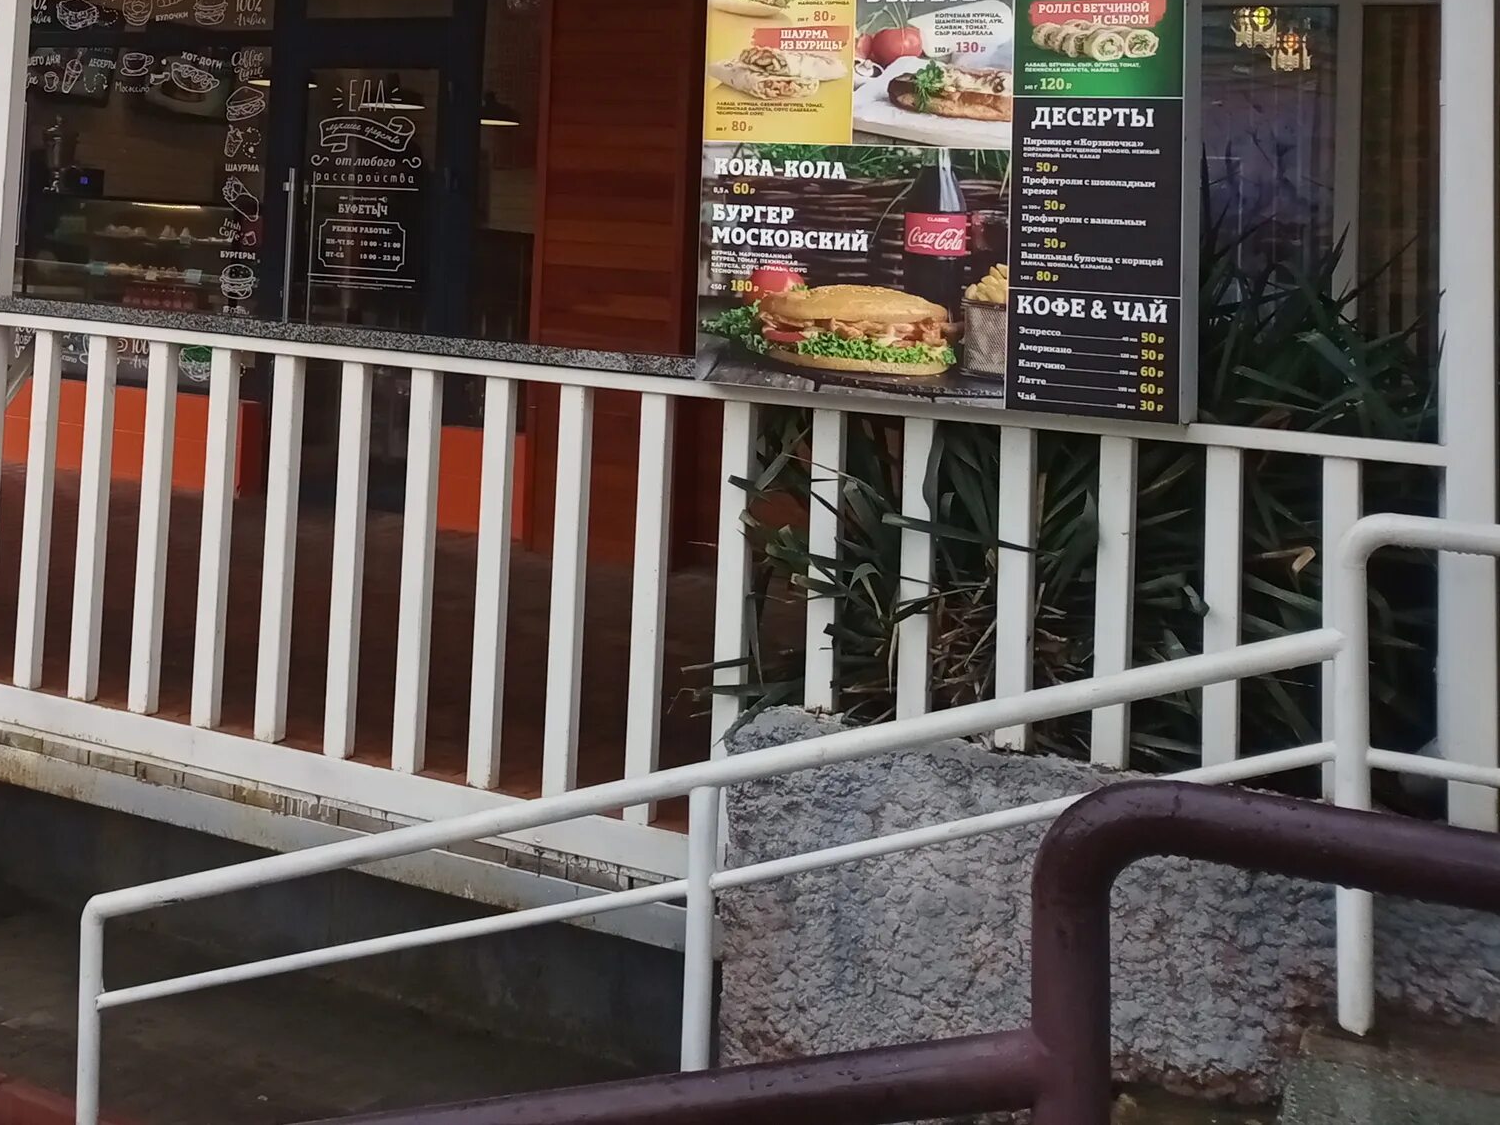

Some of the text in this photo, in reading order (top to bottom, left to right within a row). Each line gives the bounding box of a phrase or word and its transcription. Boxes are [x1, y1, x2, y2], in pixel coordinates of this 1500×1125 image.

[1038, 0, 1150, 13] РОЛЛ ВЕТЧИНОЙ
[155, 11, 189, 22] БУЛОЧКИ
[1104, 14, 1149, 25] СЫРОМ
[780, 29, 828, 40] ШАУРМА
[780, 40, 843, 51] ИЗ КУРИЦЫ
[88, 59, 116, 70] ДЕСЕРТЫ
[181, 51, 223, 69] ХОТ-ДОГИ
[348, 79, 387, 112] ЕДА
[1030, 107, 1155, 130] ДЕСЕРТЫ
[1023, 137, 1144, 148] Пирожное «Корзиночка»
[335, 155, 396, 167] от любого
[225, 163, 260, 173] ШАУРМА
[713, 157, 847, 180] КОКА-КОЛА
[316, 171, 415, 185] расстройства
[1023, 176, 1156, 189] Профитроли шоколадным
[1022, 188, 1058, 197] кремом
[712, 203, 795, 225] БУРГЕР
[1022, 213, 1147, 227] Профитроли ванильным
[223, 217, 242, 231] Irish
[1021, 226, 1058, 235] кремом
[711, 226, 869, 253] МОСКОВСКИЙ
[220, 250, 256, 260] БУРГЕРЫ
[1021, 251, 1073, 262] Ванильная
[1074, 253, 1113, 264] булочка
[1121, 257, 1164, 267] корицей
[1016, 295, 1168, 323] КОФЕ & ЧАЙ
[1018, 326, 1061, 337] Эспрессо
[1018, 342, 1072, 355] Американо
[1018, 359, 1066, 370] Капучино
[1017, 375, 1047, 385] Латте
[1017, 392, 1037, 401] Чай
